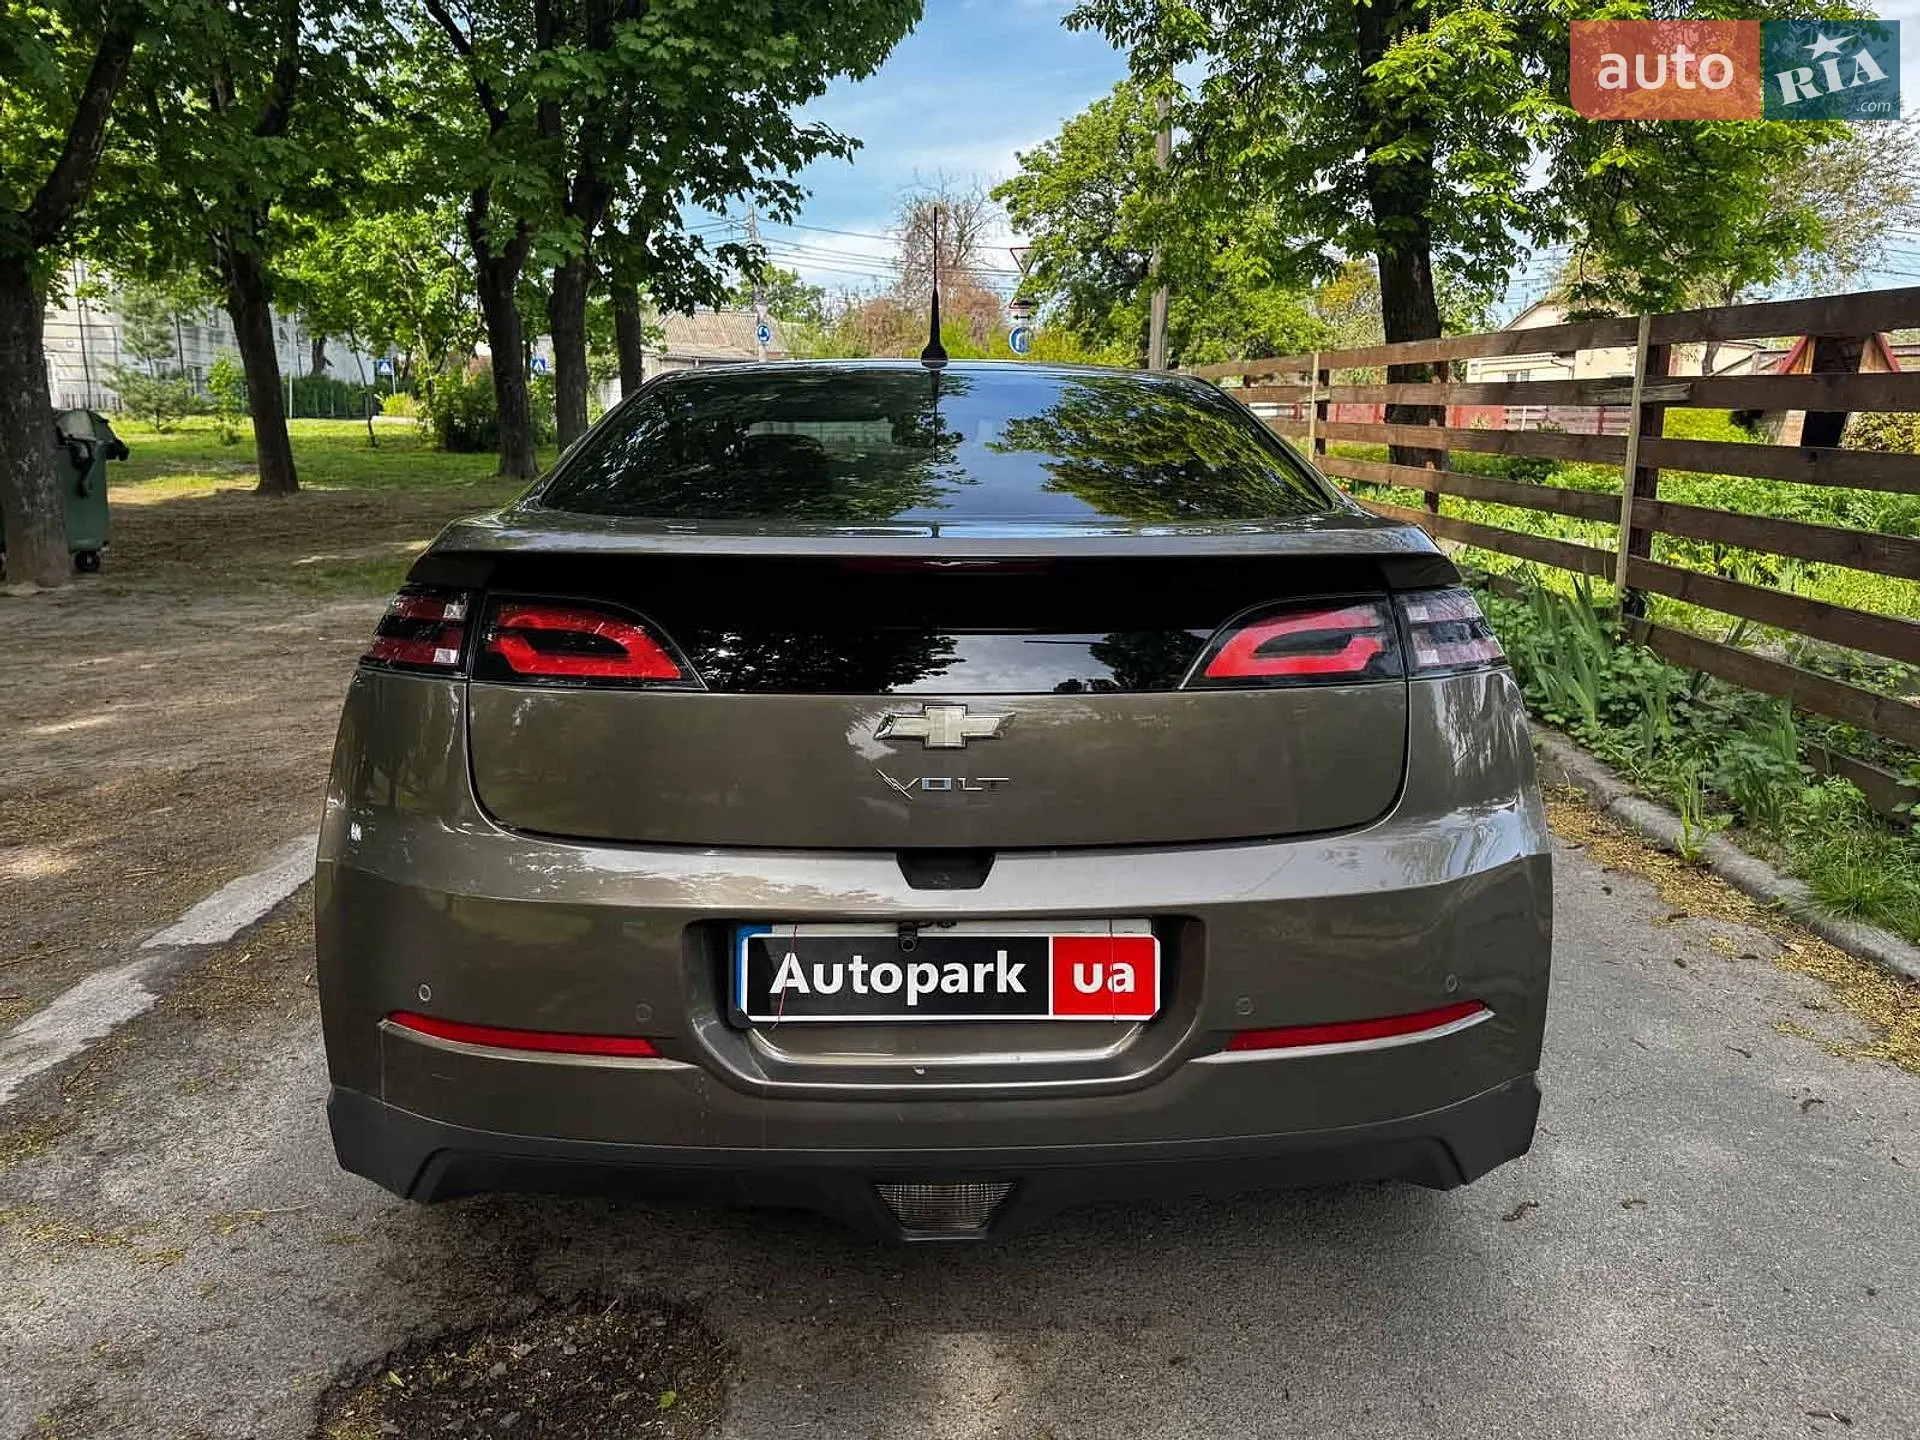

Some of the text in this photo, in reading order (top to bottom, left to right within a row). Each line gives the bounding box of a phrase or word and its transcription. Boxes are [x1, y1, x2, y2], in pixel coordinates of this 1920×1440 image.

[876, 768, 1009, 800] VOLT
[768, 950, 1136, 1006] Autopark ua
